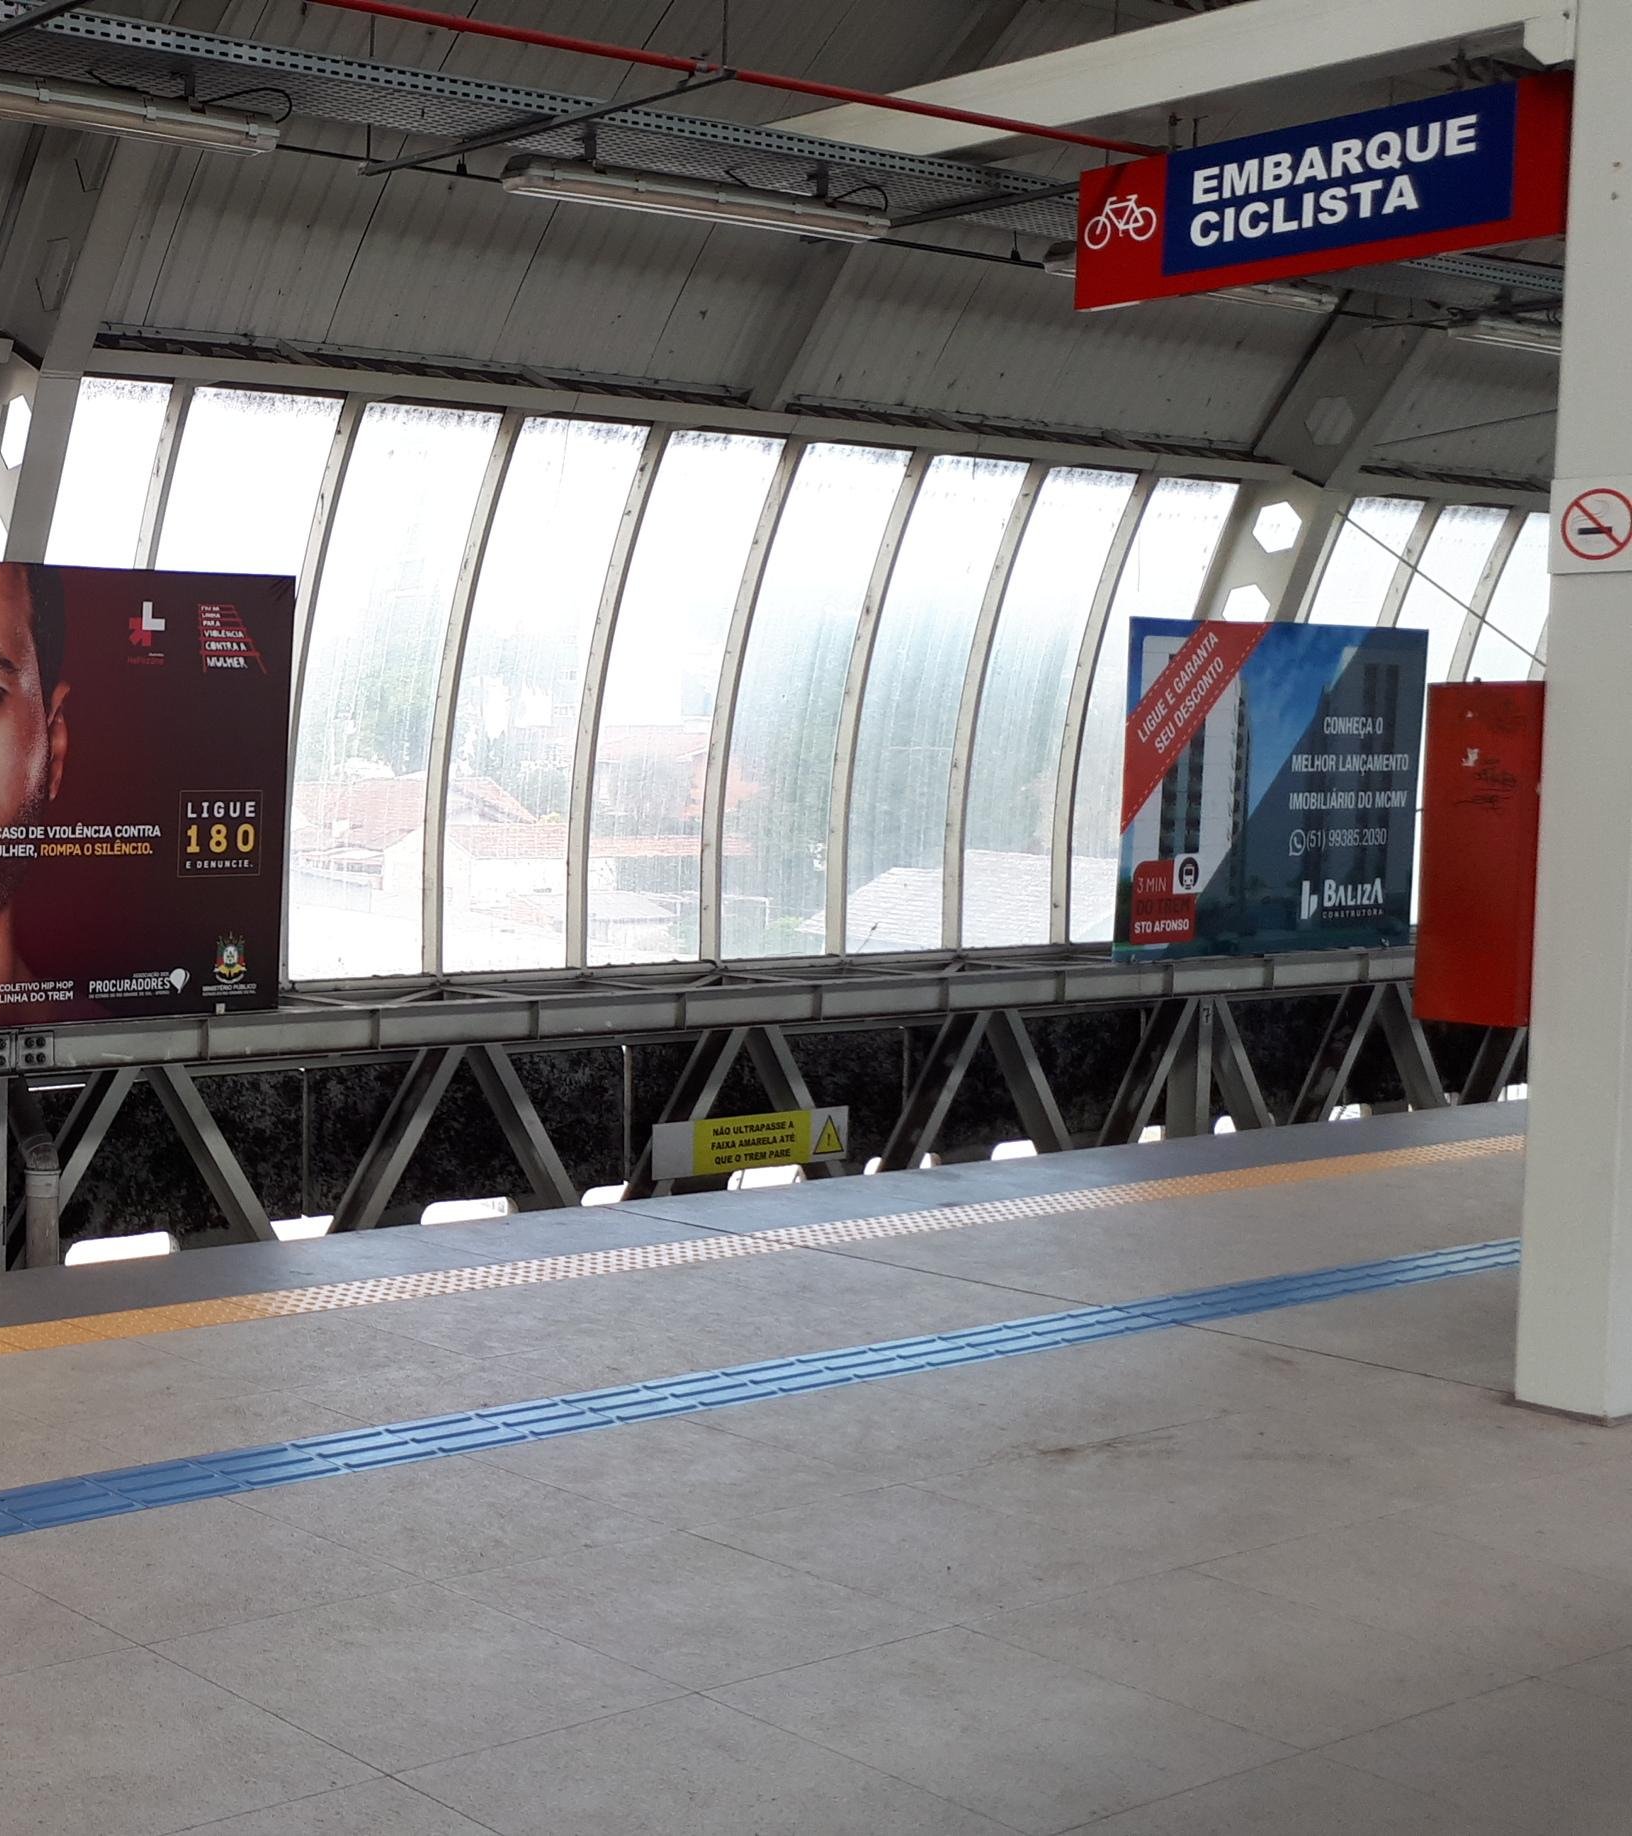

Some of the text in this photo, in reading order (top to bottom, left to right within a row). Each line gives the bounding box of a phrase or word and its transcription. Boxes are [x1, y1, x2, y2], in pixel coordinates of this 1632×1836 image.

[1191, 114, 1479, 204] EMBARQUE
[1189, 173, 1418, 247] CICLISTA
[205, 641, 247, 651] CONTRA A
[207, 656, 248, 669] MULHER
[1137, 631, 1219, 743] LIGUE E GARANTA
[1155, 656, 1225, 754] SEU DESCONTO
[1323, 716, 1383, 739] CONHEÇA O
[1291, 754, 1409, 776] MELHOR LANÇAMENTO
[1289, 788, 1407, 810] IMOBILIÁRIO DO MCMV
[186, 800, 257, 818] LIGUE
[28, 826, 45, 839] DE
[47, 822, 112, 838] VIOLÊNCIA
[114, 825, 161, 838] CONTRA
[185, 823, 256, 853] 180
[40, 843, 82, 856] ROMPA
[83, 843, 92, 855] O
[94, 839, 153, 855] SILÊNCIO.
[1306, 827, 1387, 852] (51) 99385.2030
[185, 859, 254, 869] E DENUNCIE.
[1136, 876, 1167, 893] 3 MIN
[1323, 878, 1384, 908] BALIZA
[1322, 909, 1384, 919] CONSTRUTORA
[1134, 918, 1190, 934] STO AFONSO
[41, 981, 55, 991] HIP
[56, 980, 74, 990] HOP
[88, 977, 170, 993] PROCURADORES
[30, 991, 45, 1002] DO
[46, 990, 74, 1002] TREM
[712, 1120, 795, 1136] NÃO ULTRAPASSE A
[710, 1134, 796, 1151] FAIXA AMARELA ATÉ
[714, 1149, 792, 1165] QUE O TREM PARE
